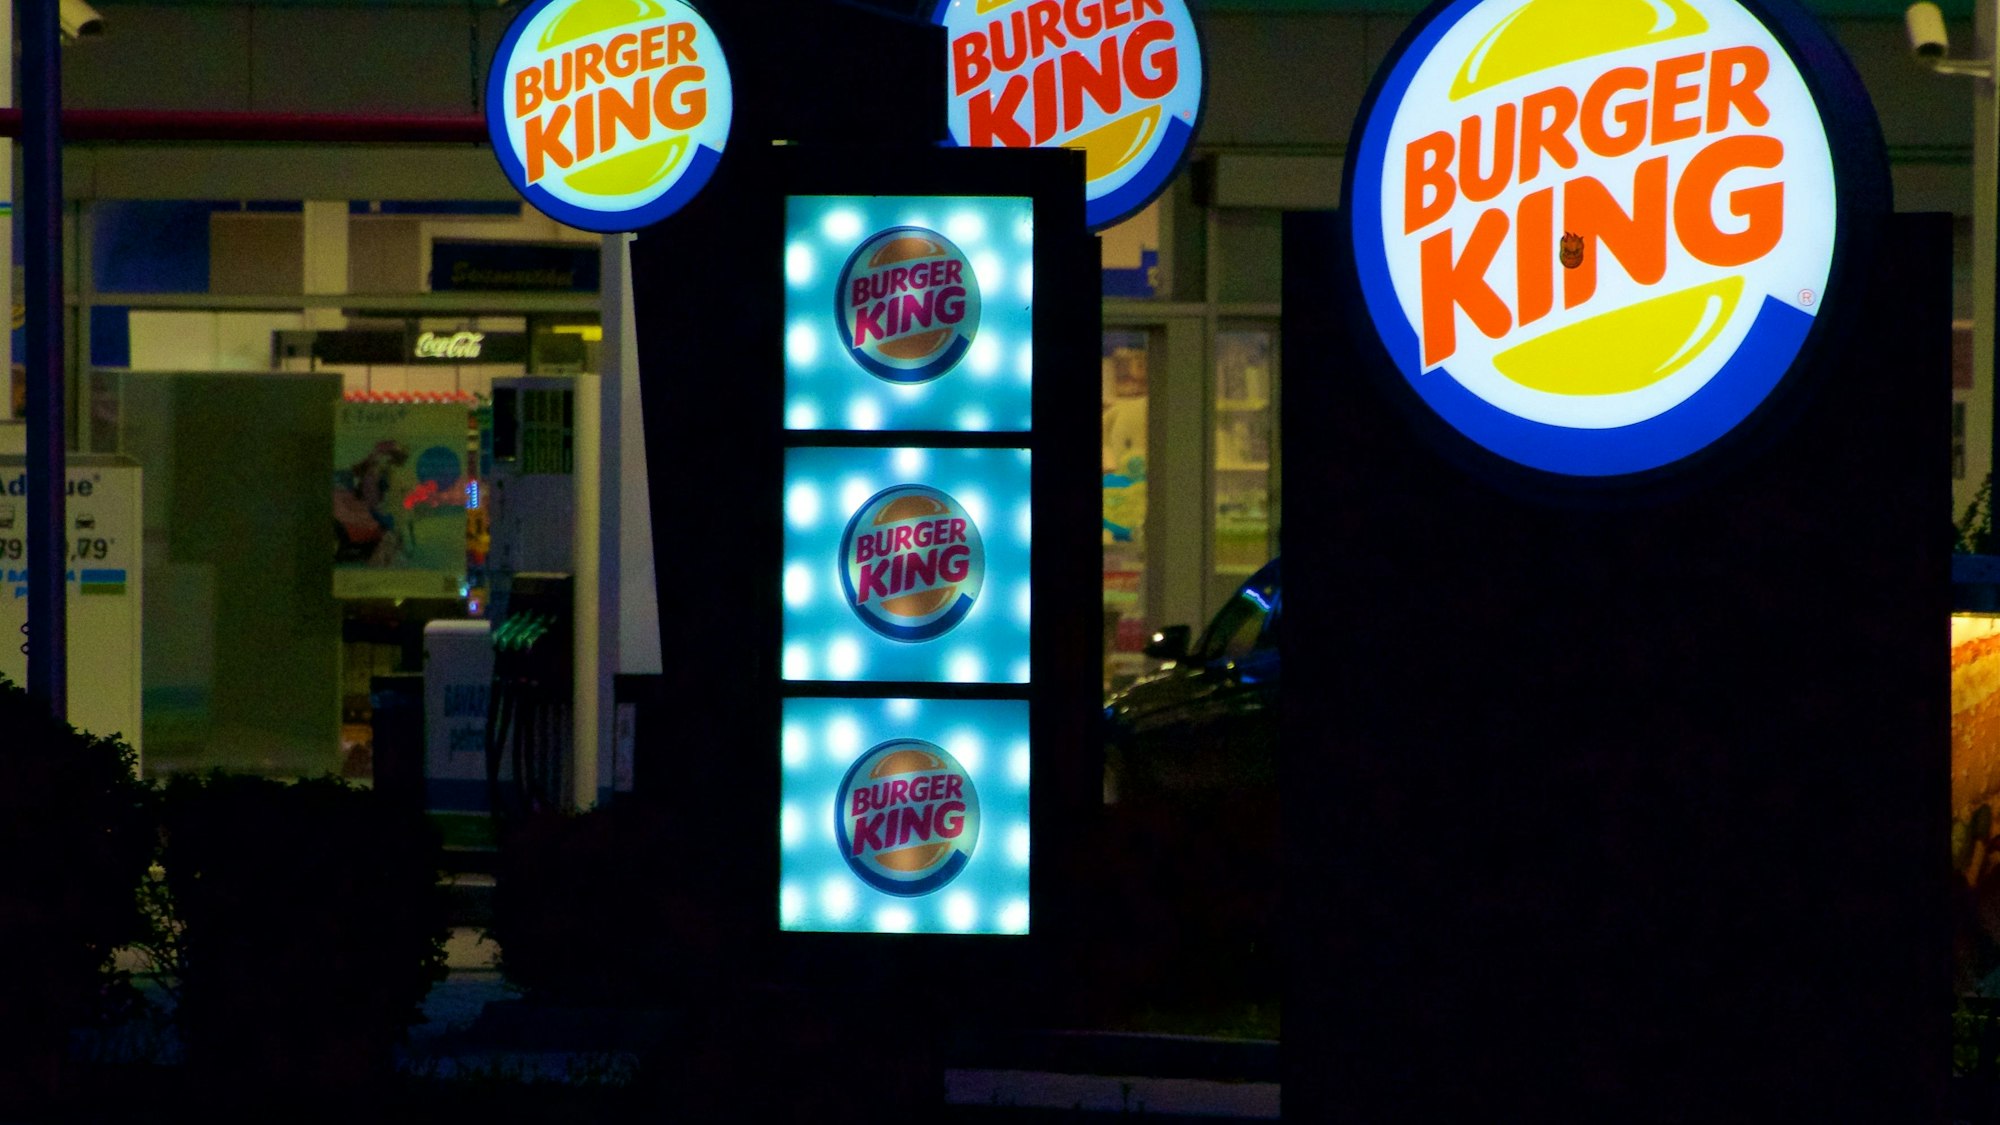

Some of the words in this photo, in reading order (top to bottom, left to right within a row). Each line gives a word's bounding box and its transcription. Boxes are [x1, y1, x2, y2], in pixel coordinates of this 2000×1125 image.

[515, 22, 698, 119] BURGER
[968, 20, 1179, 148] KING
[525, 65, 707, 184] KING
[1404, 45, 1771, 236] BURGER
[1420, 134, 1785, 368] KING
[851, 259, 963, 307] BURGER
[854, 286, 967, 347] KING
[856, 518, 967, 564] BURGER
[858, 545, 970, 604] KING
[851, 774, 963, 817] BURGER
[852, 801, 966, 857] KING
